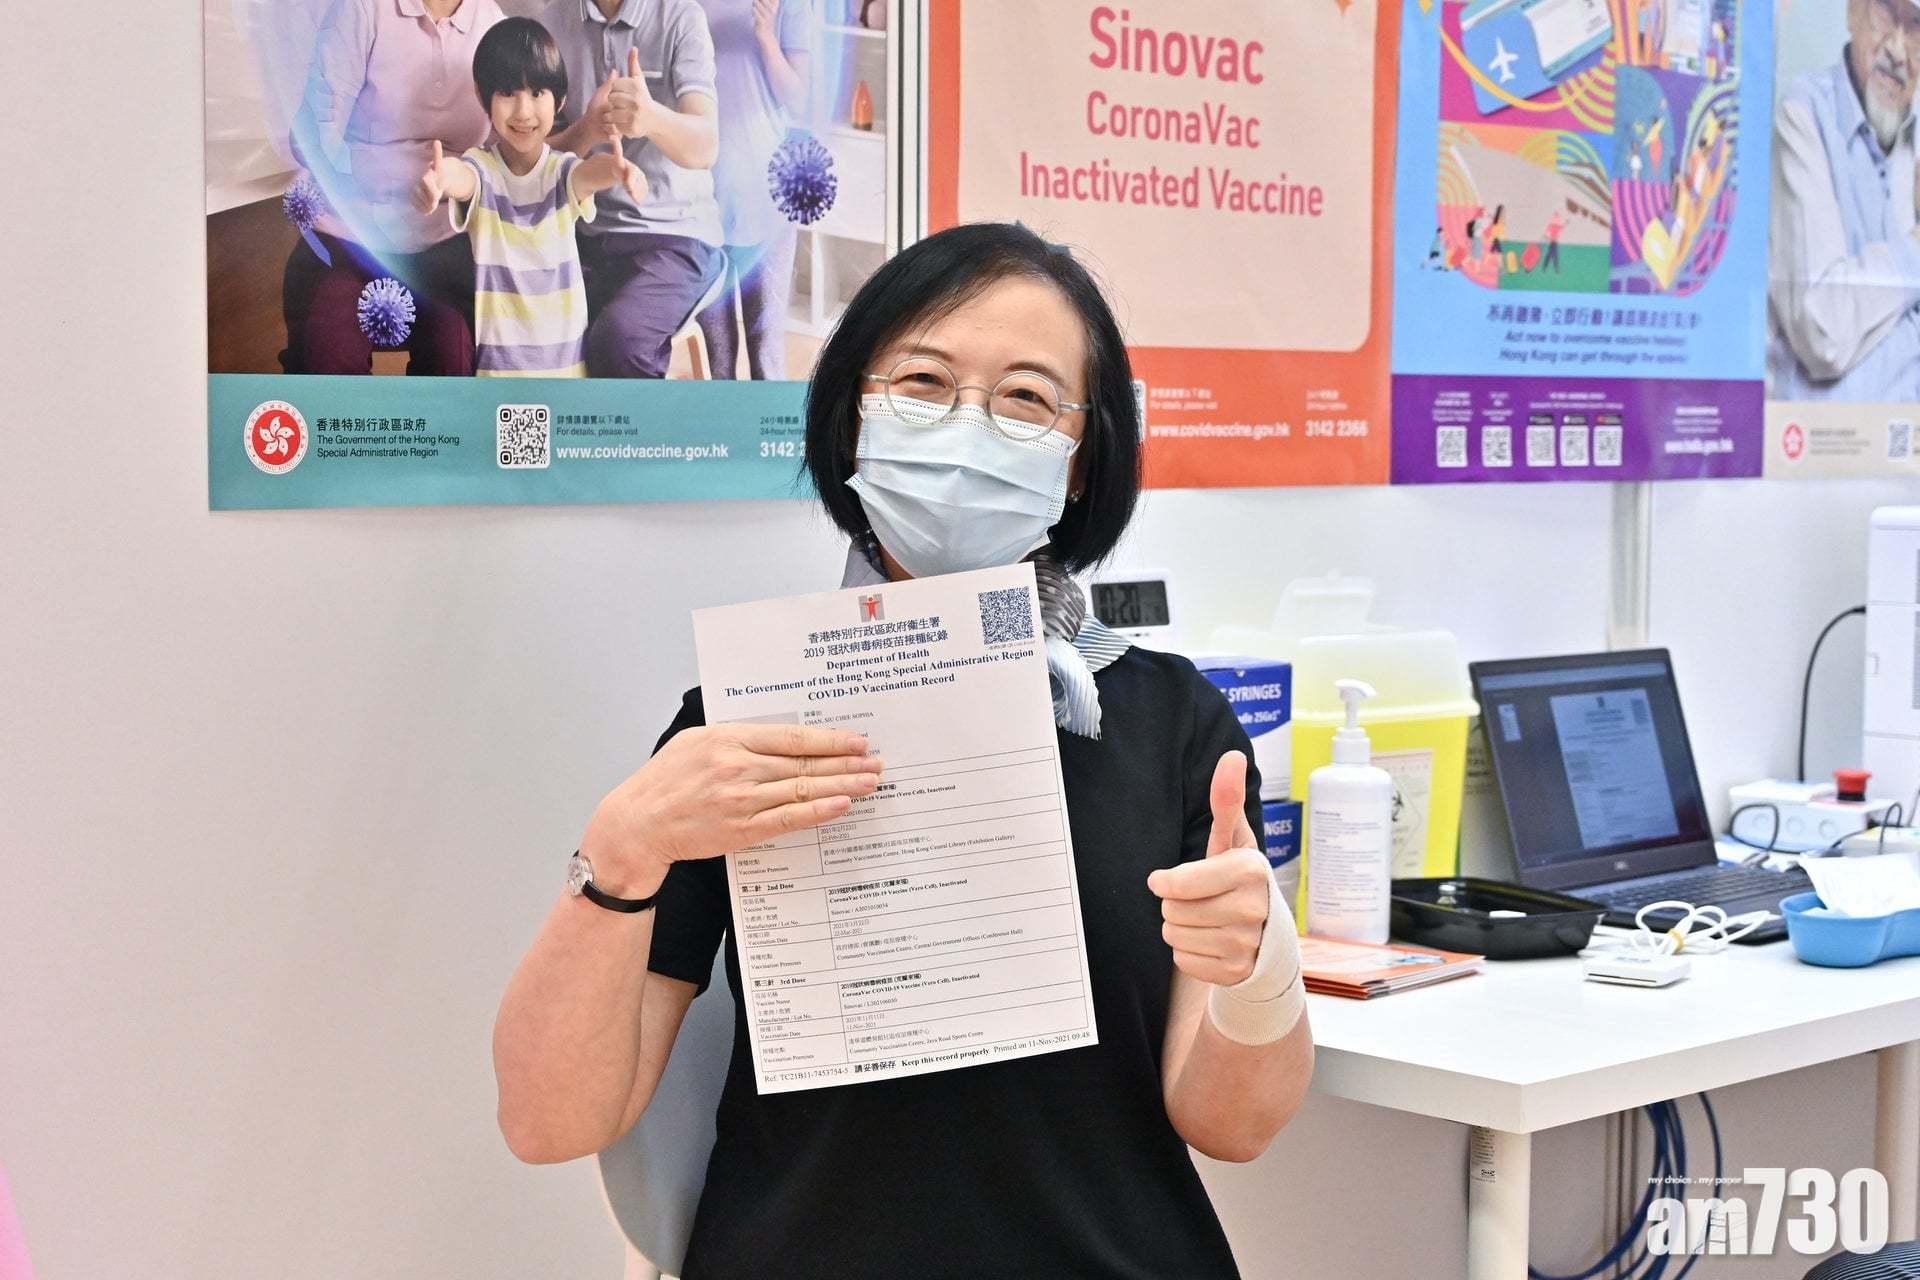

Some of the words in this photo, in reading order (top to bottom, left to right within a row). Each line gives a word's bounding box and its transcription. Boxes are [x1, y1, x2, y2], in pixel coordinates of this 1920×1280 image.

[1089, 6, 1264, 85] Sinovac
[1086, 90, 1261, 149] CoronaVac
[1019, 151, 1200, 209] Inactivated
[1208, 166, 1324, 217] Vaccine
[317, 418, 427, 432] 香港特別行政區政府
[556, 427, 569, 436] For
[598, 427, 623, 437] please
[624, 426, 638, 436] visit
[318, 435, 333, 445] The
[335, 435, 387, 445] Government
[389, 435, 398, 445] of
[399, 435, 412, 445] the
[413, 435, 436, 447] Hong
[438, 435, 460, 447] Kong
[760, 441, 794, 457] 3142
[317, 447, 348, 459] Special
[350, 447, 409, 458] Administrative
[410, 448, 439, 459] Region
[556, 443, 729, 462] www.covidvaccine.gov.hk
[803, 646, 825, 659] 2019
[826, 656, 887, 671] Department
[887, 653, 895, 662] of
[898, 649, 930, 660] Health
[725, 688, 743, 697] The
[745, 681, 804, 694] Government
[807, 677, 816, 687] of
[819, 676, 834, 685] the
[836, 674, 862, 683] Hong
[865, 670, 891, 679] Kong
[893, 663, 926, 677] Special
[930, 654, 999, 670] Administrative
[1002, 649, 1034, 660] Region
[808, 686, 859, 700] COVID-19
[862, 680, 918, 693] Vaccination
[921, 673, 955, 686] Record
[1228, 683, 1281, 703] SYRINGES
[850, 795, 874, 804] OVID-19
[829, 895, 858, 903] CoronaVac
[859, 891, 887, 899] COVID-19
[842, 990, 871, 998] CoronaVac
[765, 1074, 776, 1082] Ref.
[936, 1052, 961, 1062] record
[960, 1048, 989, 1060] properly
[993, 1043, 1017, 1053] Printed
